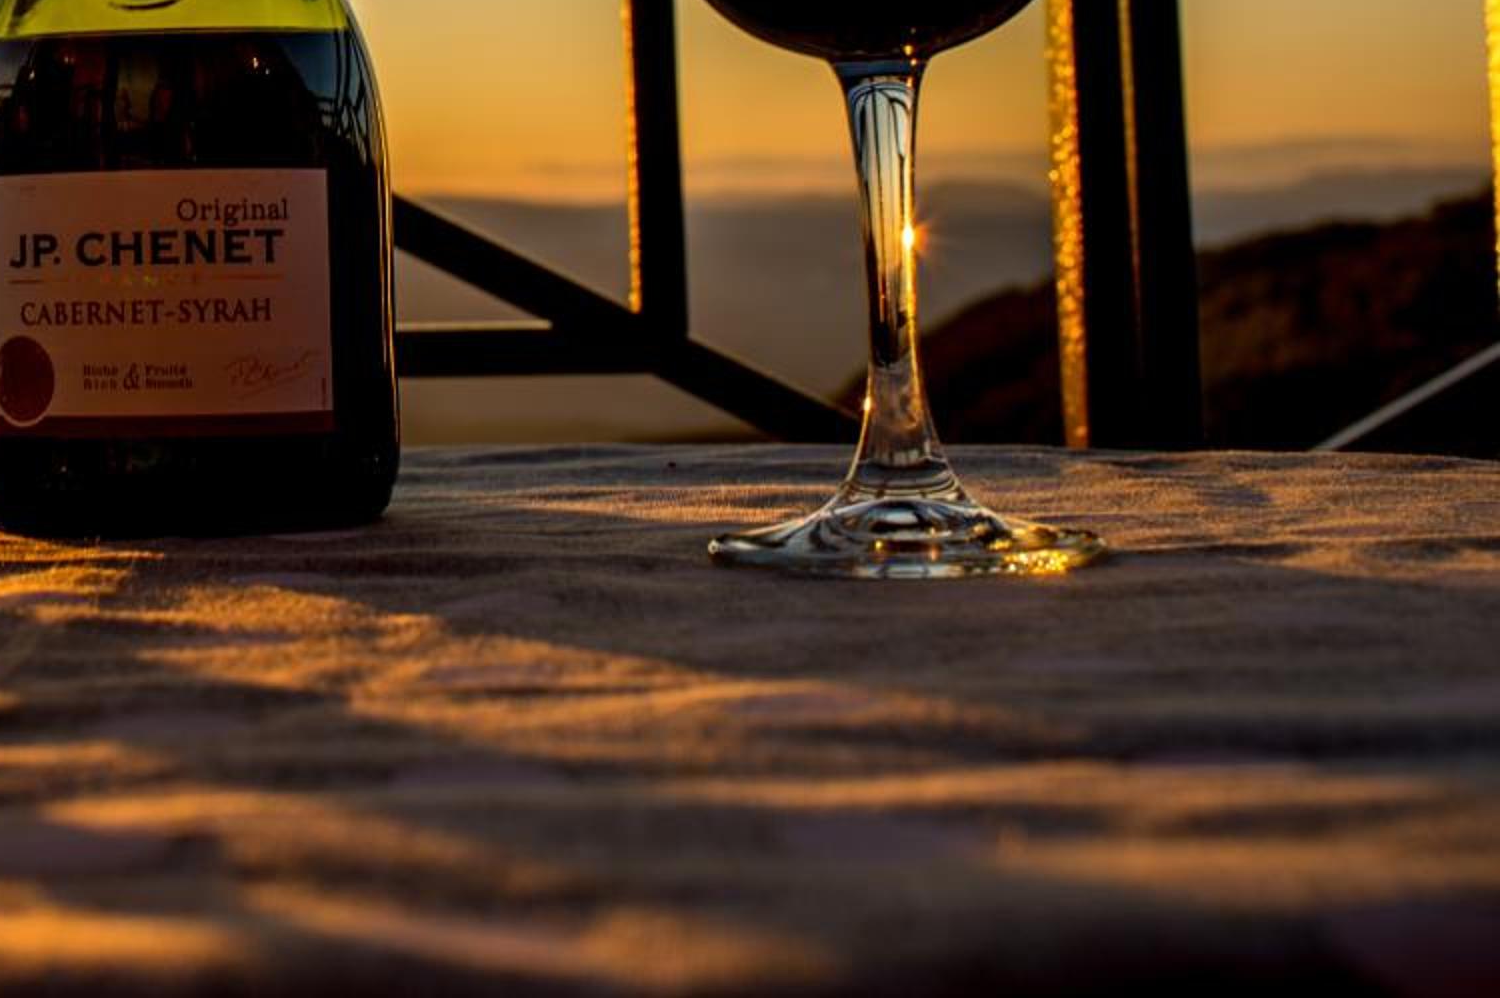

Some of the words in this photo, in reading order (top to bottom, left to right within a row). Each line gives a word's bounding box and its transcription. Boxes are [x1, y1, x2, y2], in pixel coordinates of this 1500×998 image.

[176, 198, 289, 226] Original
[9, 233, 61, 269] JP.
[76, 228, 284, 267] CHENET
[20, 298, 272, 326] CABERNET-SYRAH
